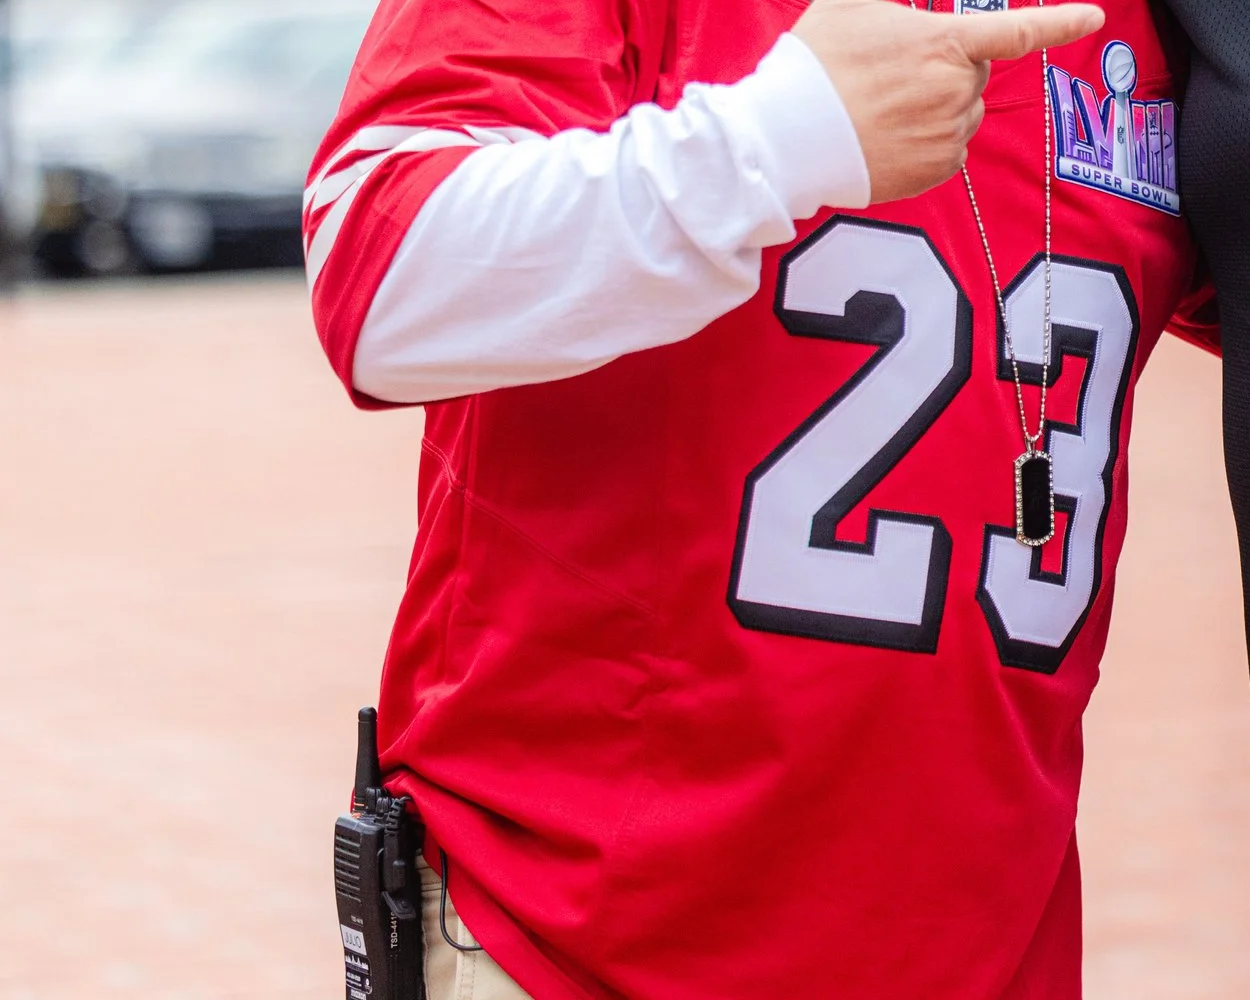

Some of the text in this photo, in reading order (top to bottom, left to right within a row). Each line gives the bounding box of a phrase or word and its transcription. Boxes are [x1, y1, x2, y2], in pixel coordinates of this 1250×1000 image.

[1071, 164, 1171, 206] SUPER BOWL
[726, 214, 1141, 675] 23
